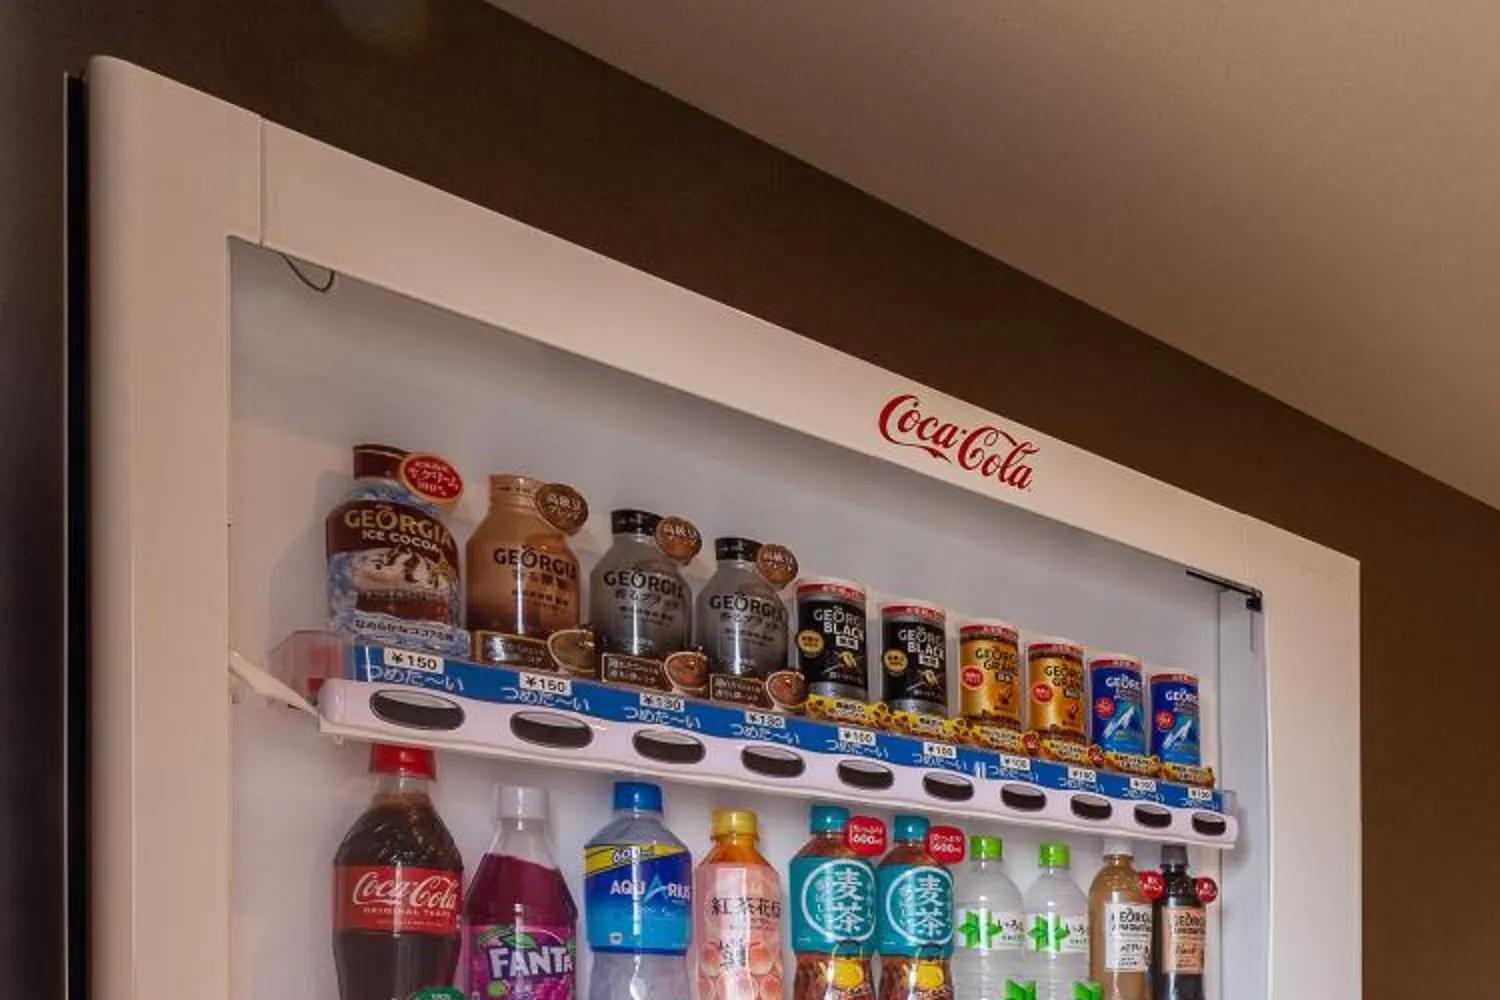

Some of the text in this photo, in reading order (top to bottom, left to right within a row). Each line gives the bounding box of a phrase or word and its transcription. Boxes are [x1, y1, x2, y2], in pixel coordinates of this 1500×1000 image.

[879, 394, 1040, 490] Coca-Cola
[362, 529, 440, 552] ICE COCOA
[391, 653, 437, 671] ¥150
[352, 871, 459, 909] Coca-Cola
[832, 868, 866, 933] 麦茶
[914, 874, 945, 937] 麦茶
